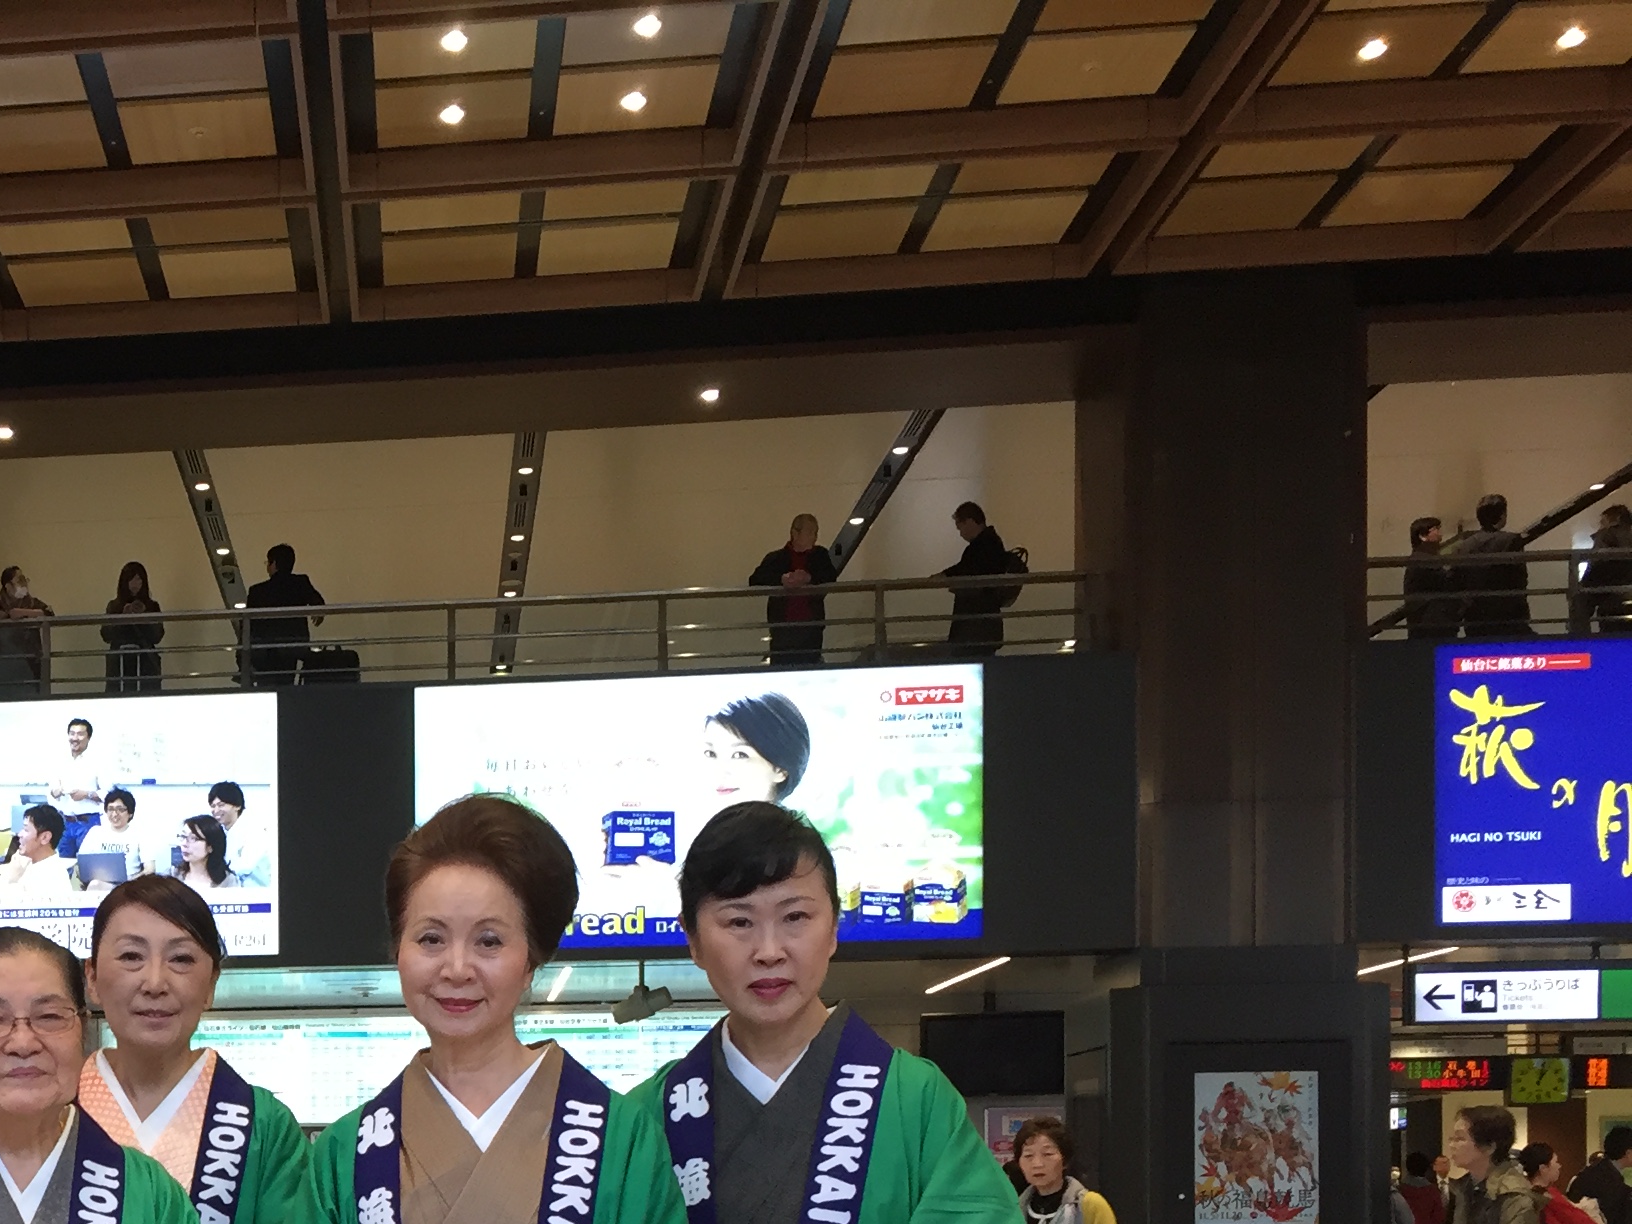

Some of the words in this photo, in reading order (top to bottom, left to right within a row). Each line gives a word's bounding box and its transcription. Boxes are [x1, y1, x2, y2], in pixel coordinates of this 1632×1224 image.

[1460, 657, 1547, 671] 仙台に銘菓あり
[898, 688, 961, 703] ヤマザキ
[617, 817, 643, 827] Royal
[643, 817, 671, 826] Bread
[1450, 832, 1480, 842] HAGI
[1484, 832, 1503, 841] NO
[1506, 831, 1542, 841] TSUKI
[1502, 978, 1580, 991] きっぷうりば
